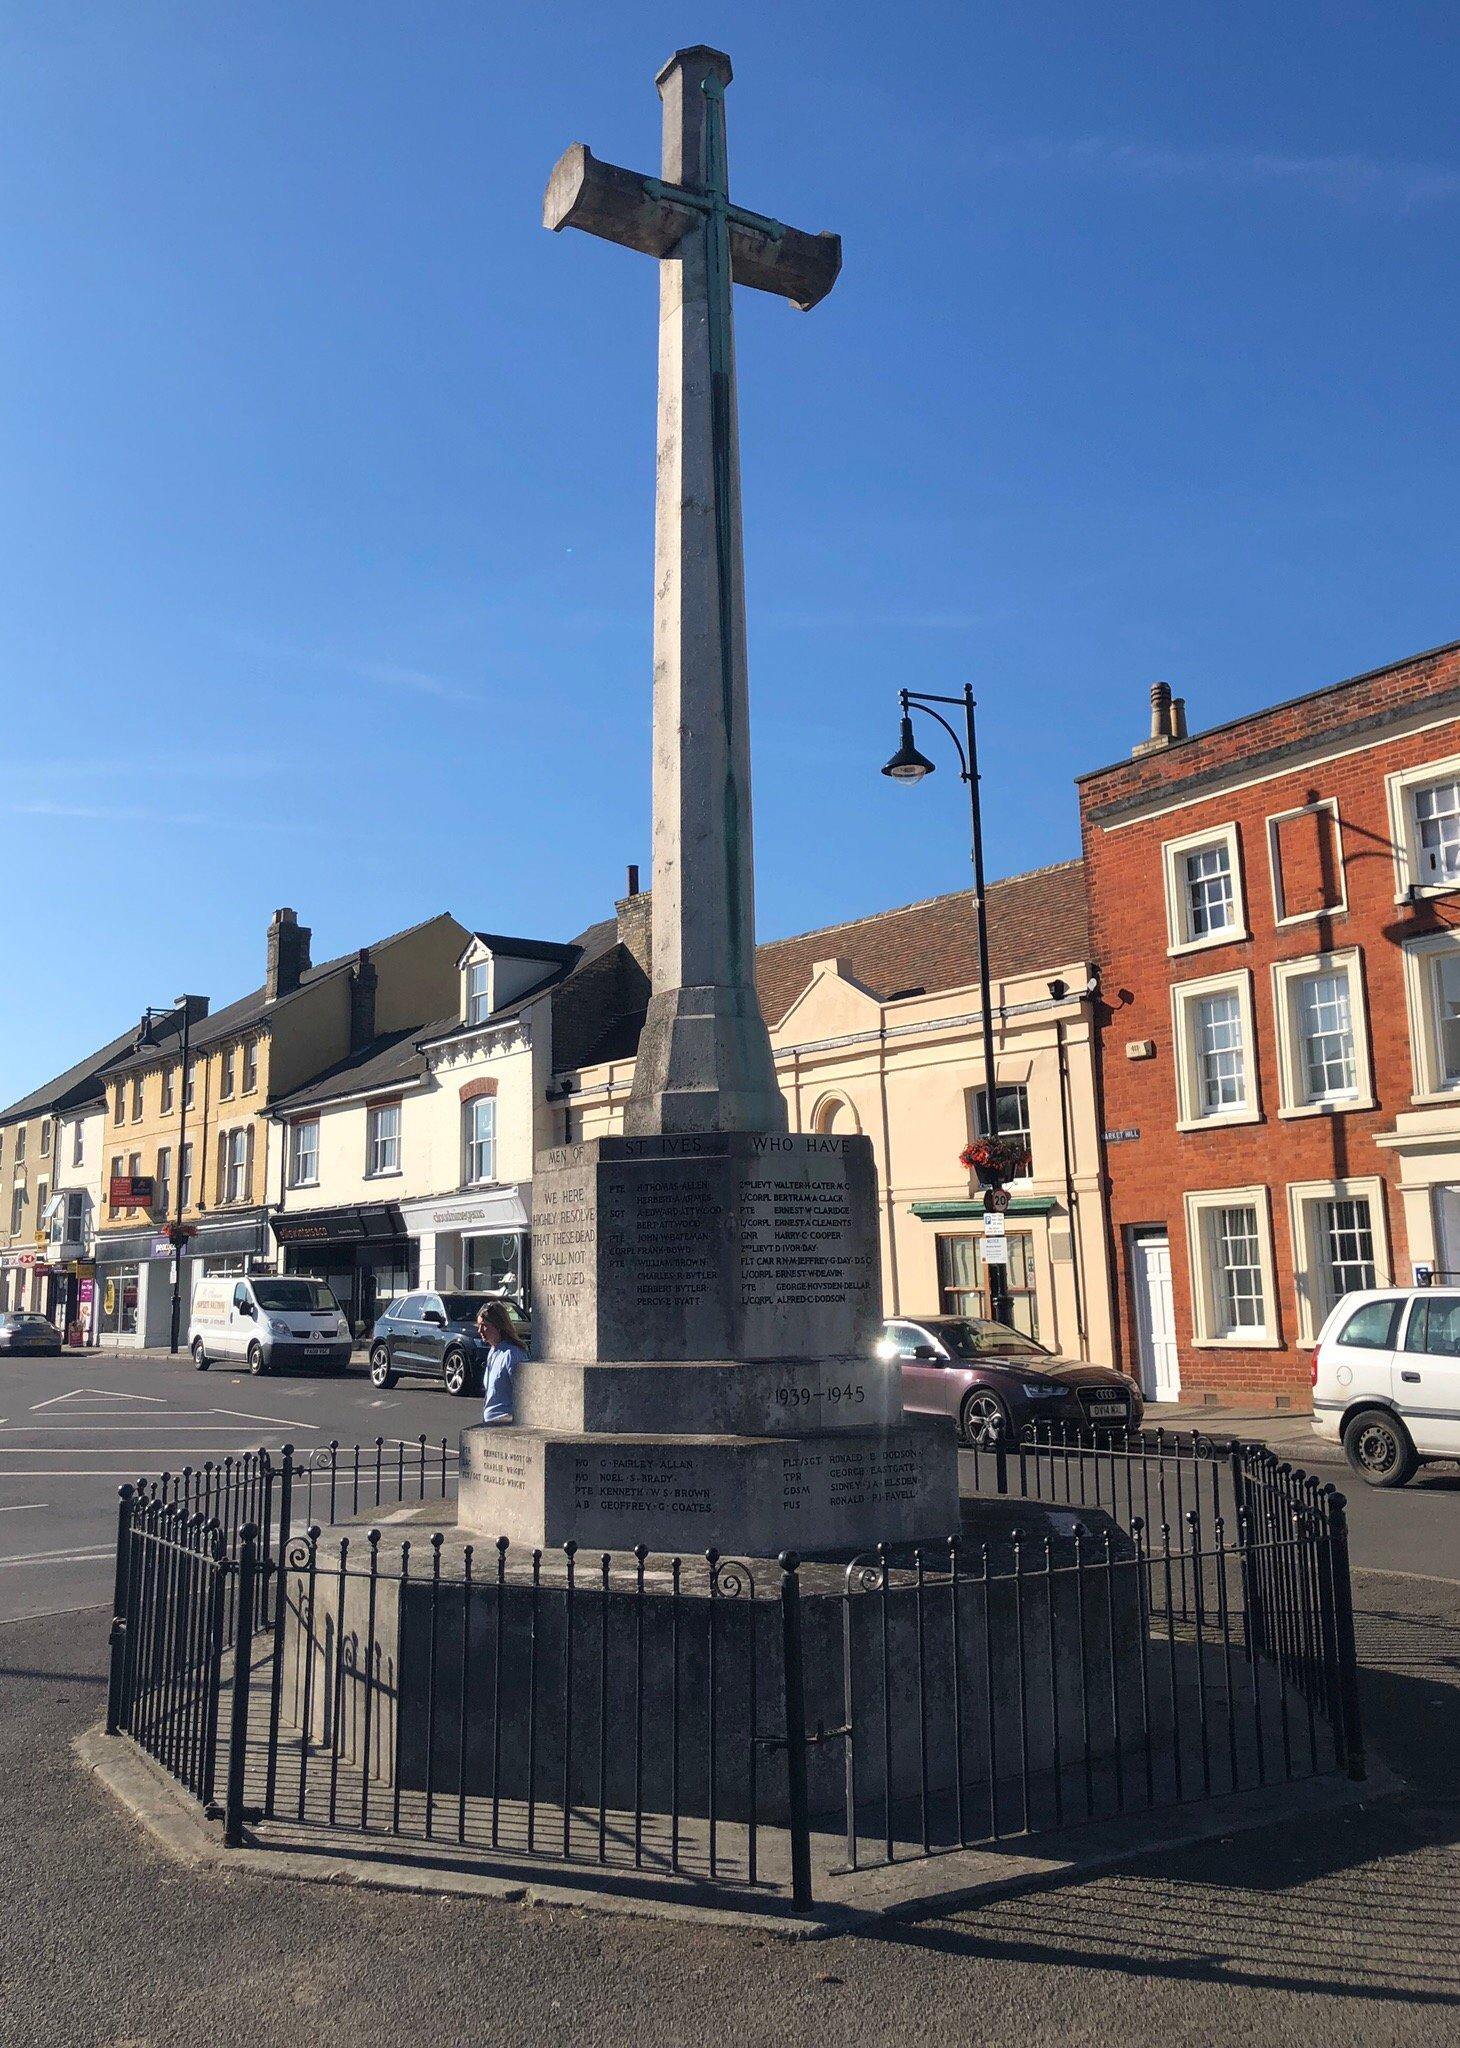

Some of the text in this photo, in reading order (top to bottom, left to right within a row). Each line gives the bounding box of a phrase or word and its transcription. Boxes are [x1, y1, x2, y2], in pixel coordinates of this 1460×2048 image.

[1124, 1130, 1139, 1138] HILL
[625, 1138, 702, 1154] ST IVES
[753, 1138, 852, 1153] WHO HAVE
[549, 1147, 584, 1164] MEN OF
[682, 1181, 709, 1191] ALLEN
[774, 1181, 804, 1190] WALTER
[812, 1181, 835, 1190] CATER
[545, 1188, 585, 1205] WE HERE
[994, 1195, 1006, 1206] 20
[560, 1207, 595, 1224] RESOLVE
[740, 1206, 756, 1214] PTE
[774, 1206, 803, 1215] ERNEST
[813, 1206, 850, 1215] CLARIDGE
[774, 1219, 804, 1227] ERNEST
[812, 1219, 852, 1227] CLEMENTS
[533, 1229, 595, 1247] THAT THESE DEAD
[774, 1231, 800, 1240] HARRY
[809, 1231, 842, 1240] COOPER
[802, 1244, 819, 1252] DAY
[541, 1250, 586, 1267] SHALL NOT
[542, 1271, 585, 1287] HAVE DIED
[637, 1271, 676, 1280] CHARLES
[774, 1269, 806, 1279] ERNEST
[636, 1284, 673, 1294] HERBERT
[741, 1282, 757, 1291] PTE
[775, 1282, 806, 1291] GEORGE
[547, 1293, 579, 1307] IN VAIN
[636, 1296, 664, 1306] PERCY
[776, 1295, 806, 1304] ALFRED
[814, 1294, 846, 1303] DODSON
[829, 1453, 863, 1464] RONALD
[599, 1473, 625, 1482] NOEL
[641, 1474, 674, 1483] BRADY
[829, 1467, 865, 1478] GEORGE
[830, 1480, 862, 1492] SIDNEY
[574, 1486, 594, 1496] PTE
[599, 1487, 644, 1497] KENNETH
[674, 1489, 711, 1499] BROWN
[830, 1494, 865, 1506] RONALD
[885, 1489, 916, 1501] FAVELL
[600, 1500, 652, 1511] GEOFFREY
[672, 1502, 712, 1513] COATES
